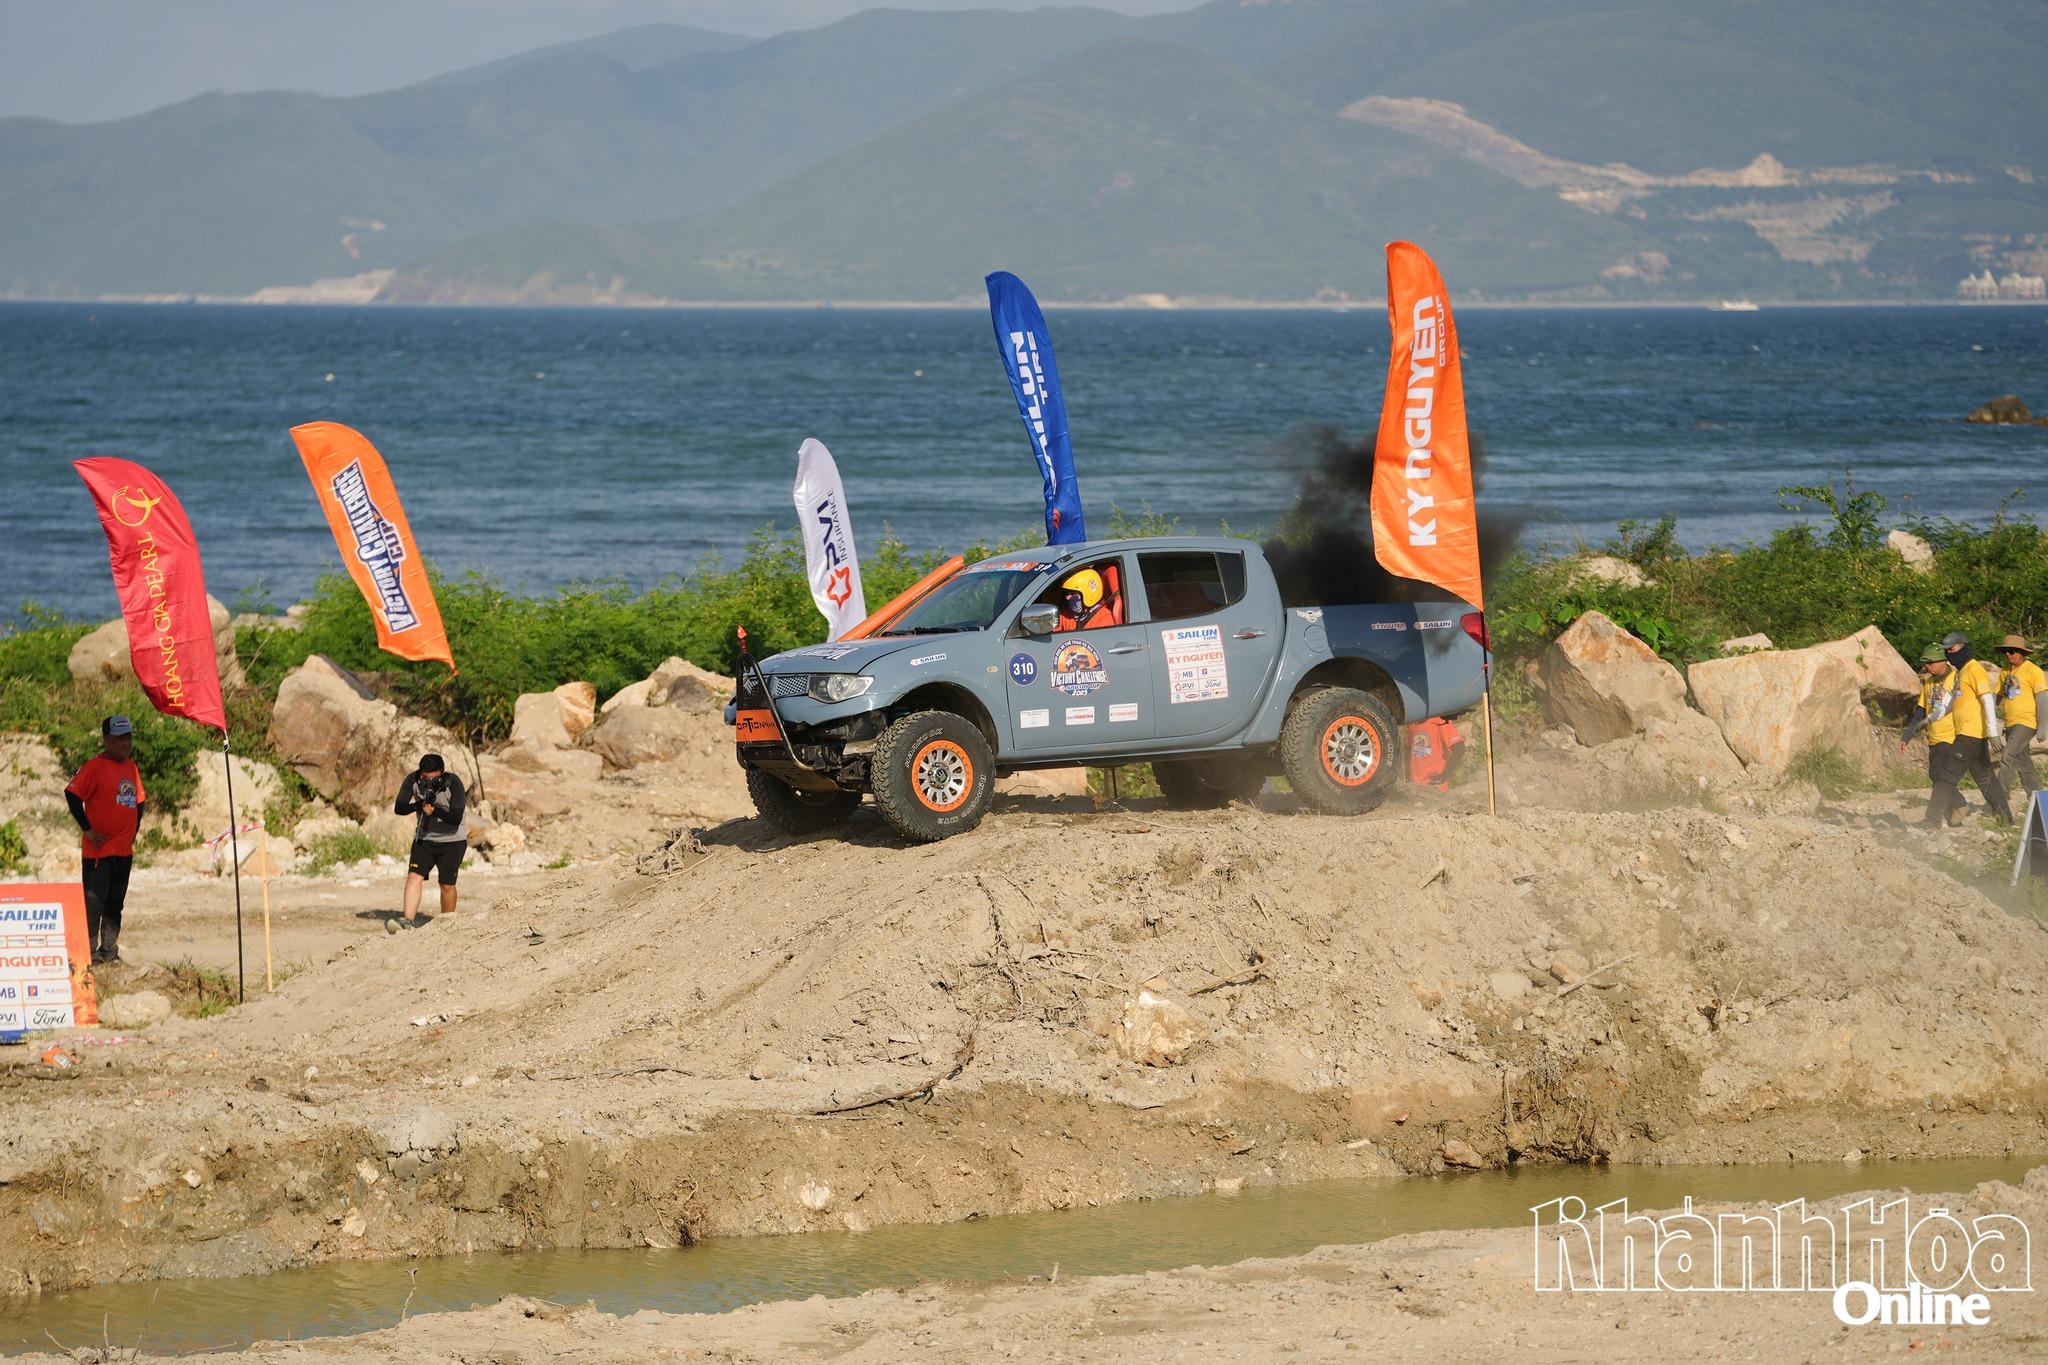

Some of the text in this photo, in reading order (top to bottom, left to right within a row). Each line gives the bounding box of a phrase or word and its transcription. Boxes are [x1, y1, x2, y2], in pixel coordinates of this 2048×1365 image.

[1026, 330, 1048, 405] TIRE
[333, 462, 387, 560] CHALLENGE
[827, 488, 848, 562] INSURANCE
[381, 521, 404, 560] CUP
[816, 499, 841, 570] PVI
[137, 531, 185, 708] HOANG GIA PEARL
[1177, 629, 1218, 640] SAILUN
[1424, 621, 1451, 629] SAILUN
[1013, 662, 1034, 675] 310
[27, 922, 56, 931] TIRE
[33, 1008, 66, 1025] Ford
